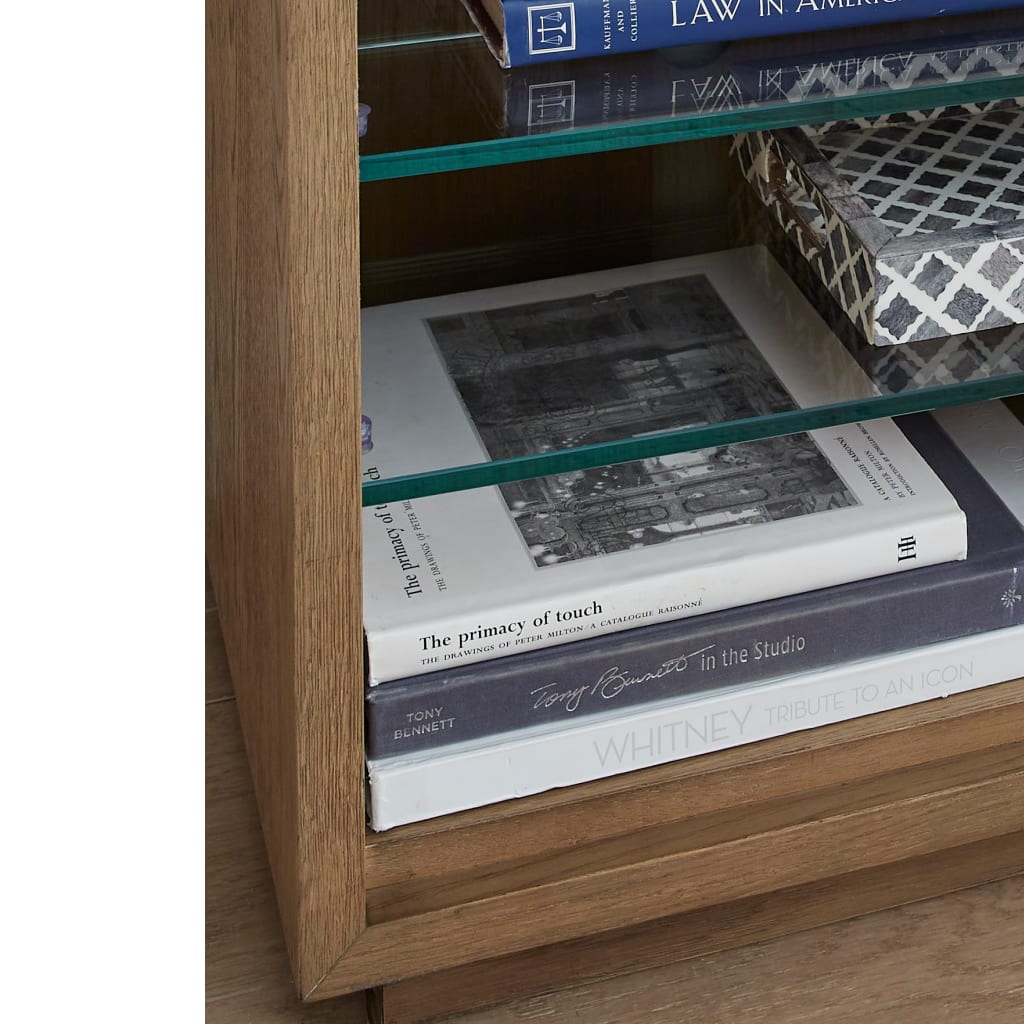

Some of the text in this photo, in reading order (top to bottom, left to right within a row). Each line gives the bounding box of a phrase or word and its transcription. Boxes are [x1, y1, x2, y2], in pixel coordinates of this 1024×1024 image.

[617, 10, 625, 32] AND
[858, 464, 886, 496] CATALOGUE
[374, 513, 394, 524] of
[408, 512, 421, 531] PETER
[416, 533, 425, 541] OF
[386, 527, 420, 572] primacy
[421, 542, 441, 576] DRAWINGS
[404, 574, 423, 598] The
[435, 579, 447, 592] THE
[419, 600, 603, 651] The primacy of touch
[420, 655, 440, 665] THE
[444, 644, 495, 661] DRAWINGS
[498, 640, 511, 649] OF
[515, 633, 543, 646] PETER
[600, 610, 654, 627] CATALOGUE
[530, 681, 591, 712] Tony
[700, 654, 716, 671] in
[722, 648, 750, 668] the
[754, 634, 807, 660] Studio
[406, 707, 444, 724] TONY
[593, 660, 974, 768] WHITNEY TRIBUTE TO AN ICON
[393, 717, 456, 740] BENNETT
